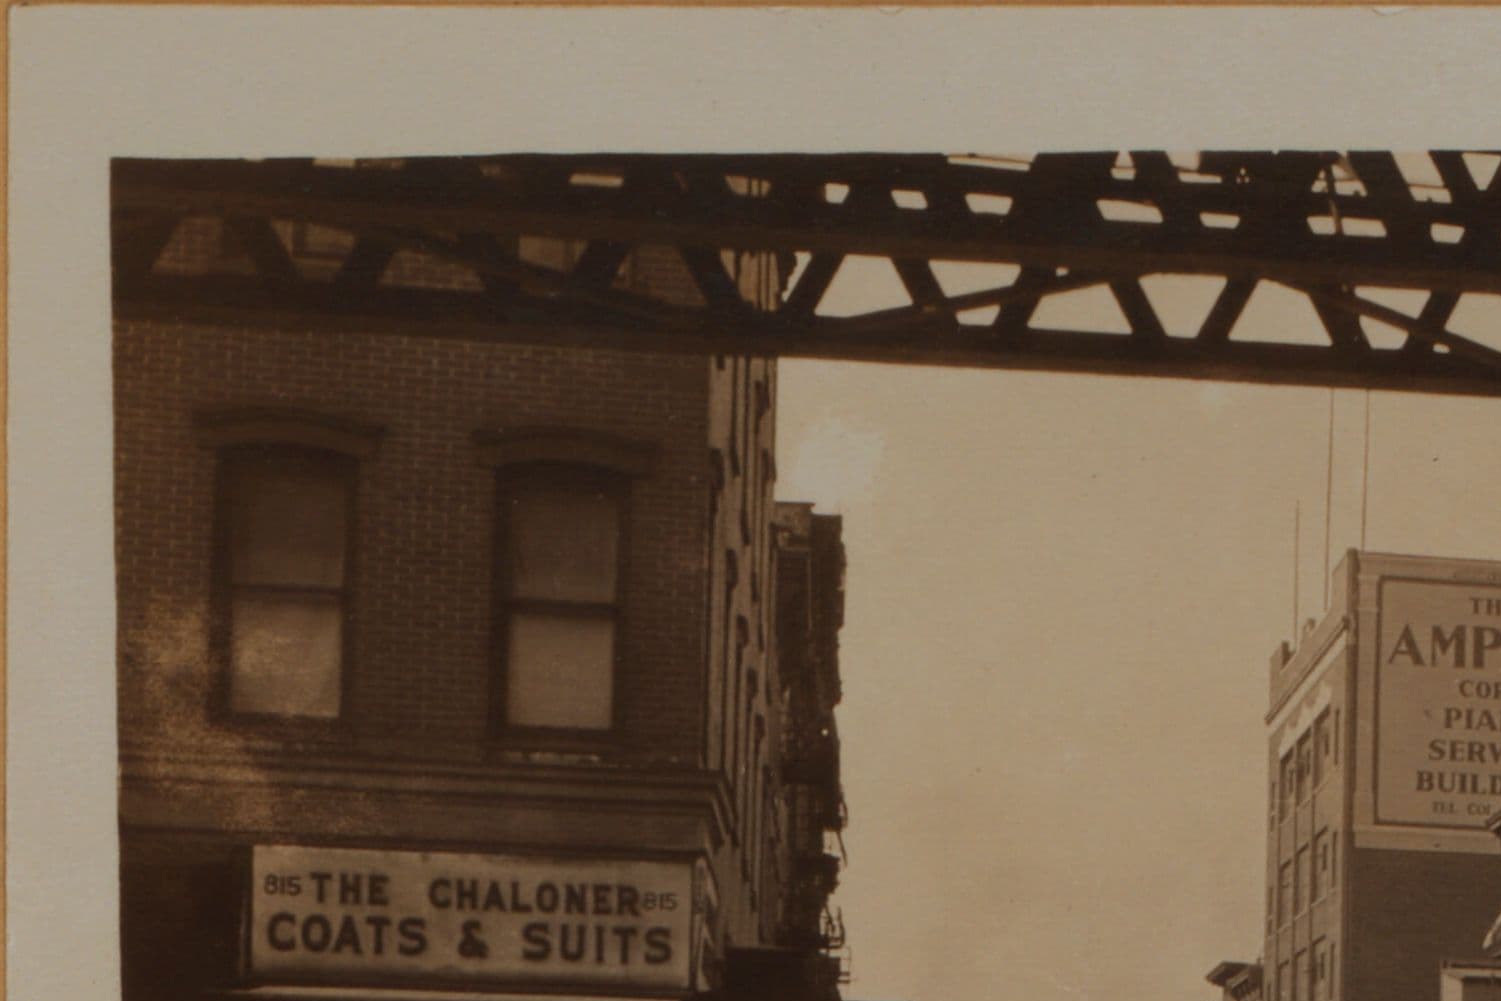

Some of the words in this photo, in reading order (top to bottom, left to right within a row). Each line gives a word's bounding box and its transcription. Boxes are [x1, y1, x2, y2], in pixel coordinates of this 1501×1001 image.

[263, 874, 302, 897] 815
[311, 872, 391, 906] THE
[428, 878, 642, 917] CHALONER
[642, 892, 677, 911] 815
[267, 913, 428, 957] COATS
[458, 920, 489, 960] &
[521, 922, 673, 965] SUITS
